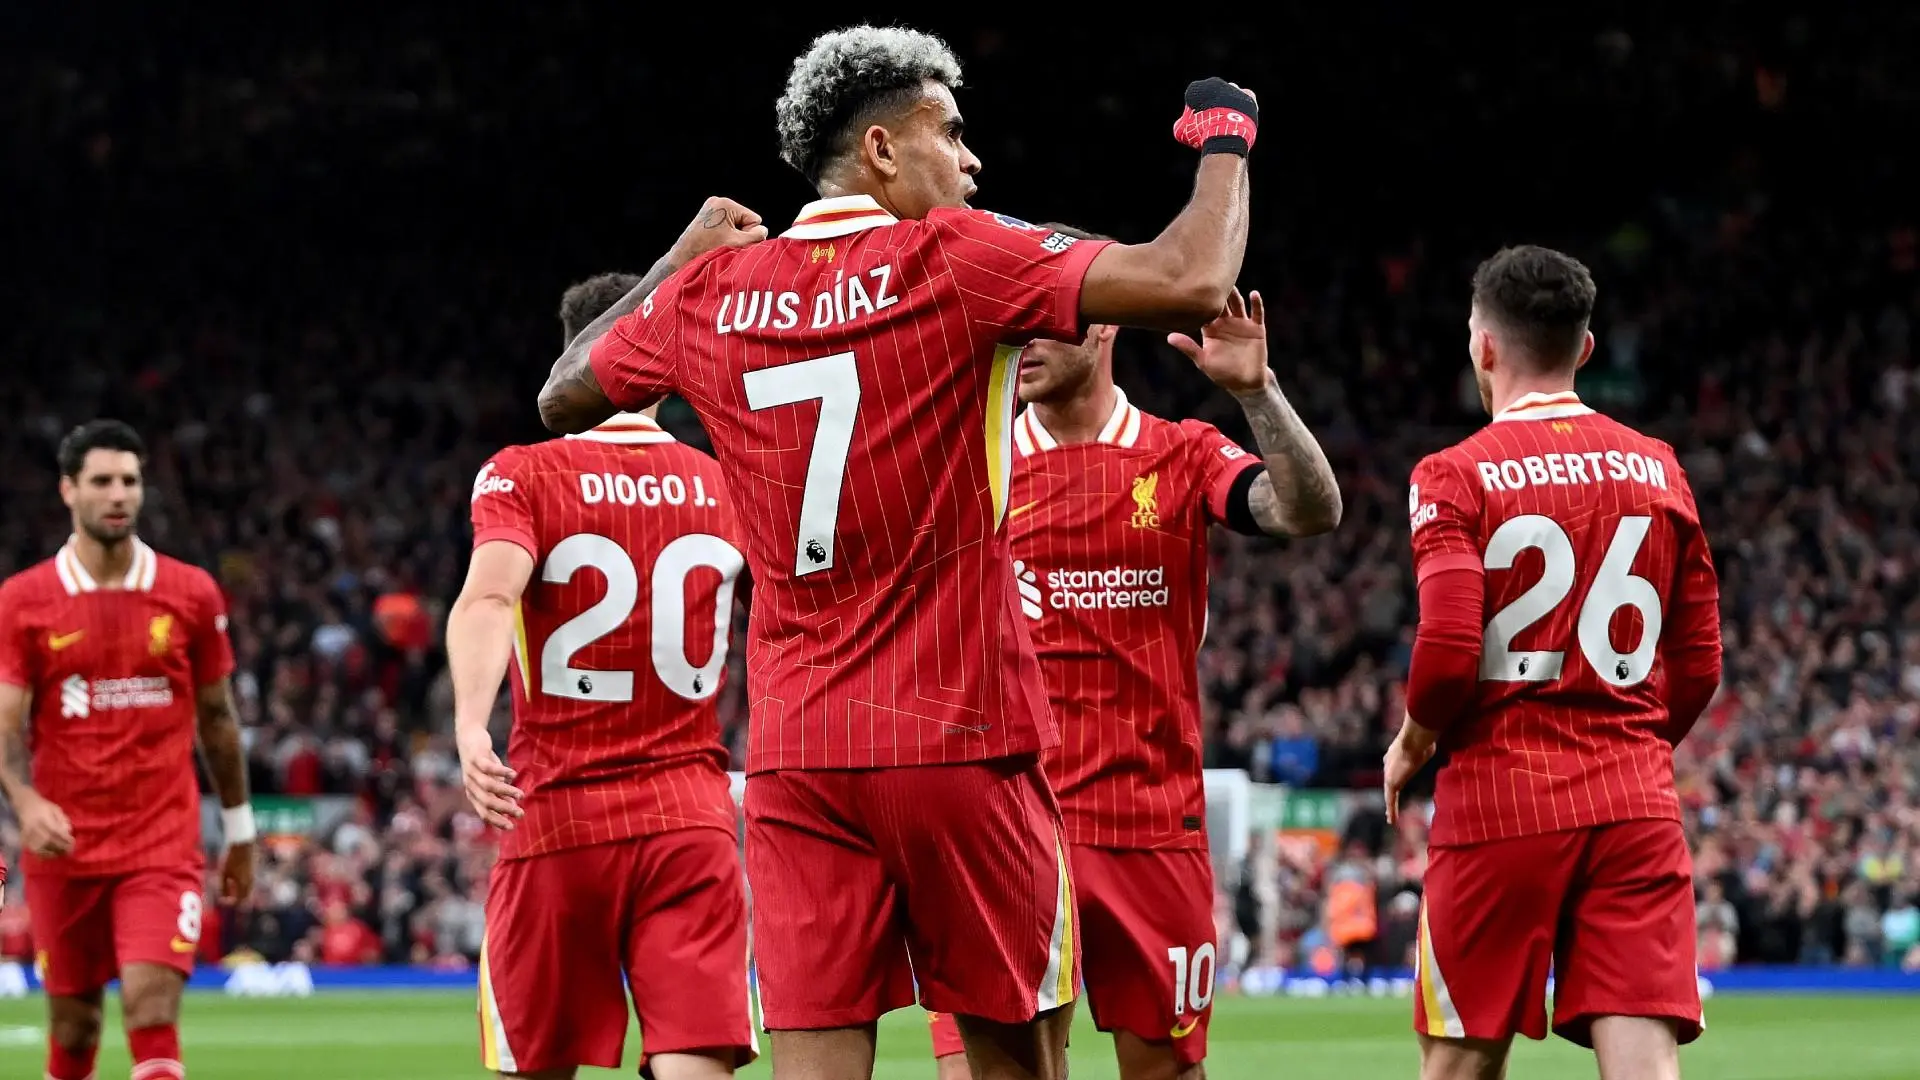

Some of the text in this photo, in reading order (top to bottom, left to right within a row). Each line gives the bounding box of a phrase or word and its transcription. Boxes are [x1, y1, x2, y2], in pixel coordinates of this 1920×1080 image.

[717, 291, 800, 335] LUIS
[811, 264, 899, 329] DÍAZ
[742, 350, 861, 577] 7
[1477, 450, 1668, 491] ROBERTSON
[579, 473, 716, 507] DIOGO J.
[1131, 514, 1161, 528] LFC
[1047, 565, 1164, 589] standard
[1050, 586, 1169, 610] chartered
[1479, 514, 1663, 687] 26
[541, 533, 745, 702] 20
[177, 890, 202, 942] 8
[1167, 941, 1216, 1016] 10
